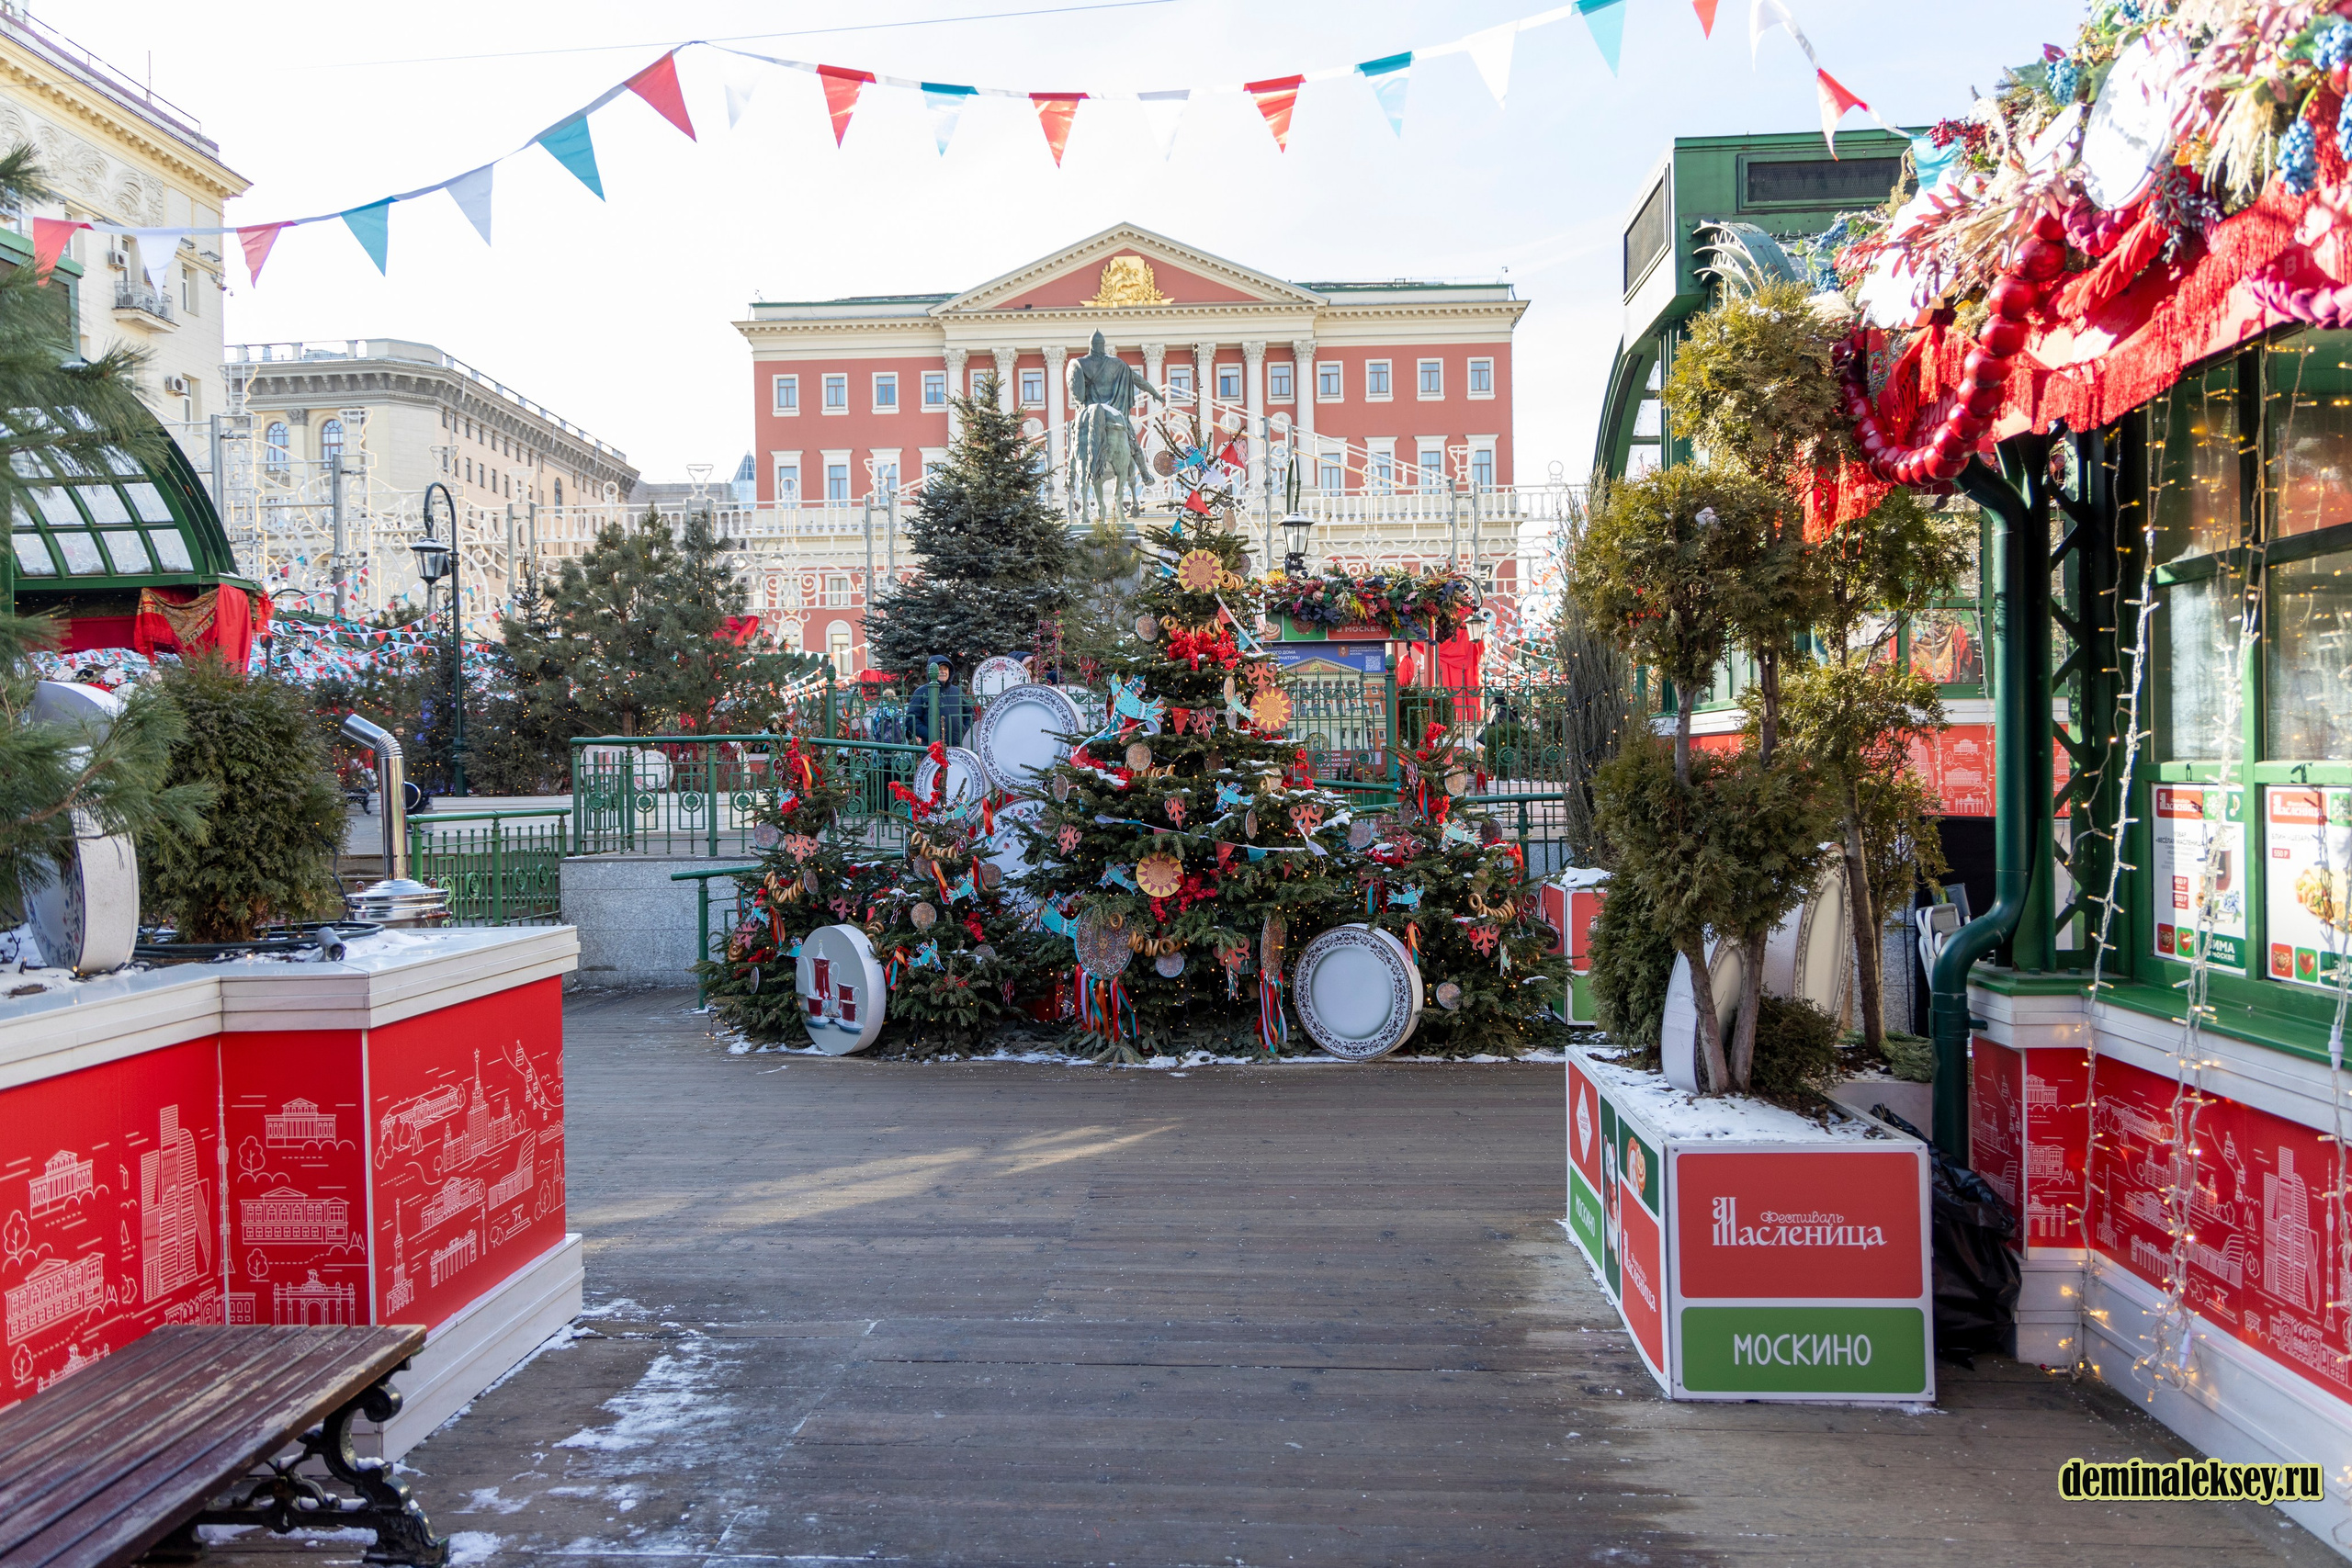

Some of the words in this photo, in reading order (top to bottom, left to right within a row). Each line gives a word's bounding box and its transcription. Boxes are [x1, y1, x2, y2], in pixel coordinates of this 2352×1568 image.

[1917, 391, 1957, 431] ЗИМ
[2211, 939, 2235, 954] ИМА
[1574, 1192, 1596, 1239] МОСКИНО
[1712, 1196, 1888, 1250] Масленица
[1760, 1211, 1845, 1225] Фестиваль
[1733, 1333, 1873, 1367] МОСКИНО
